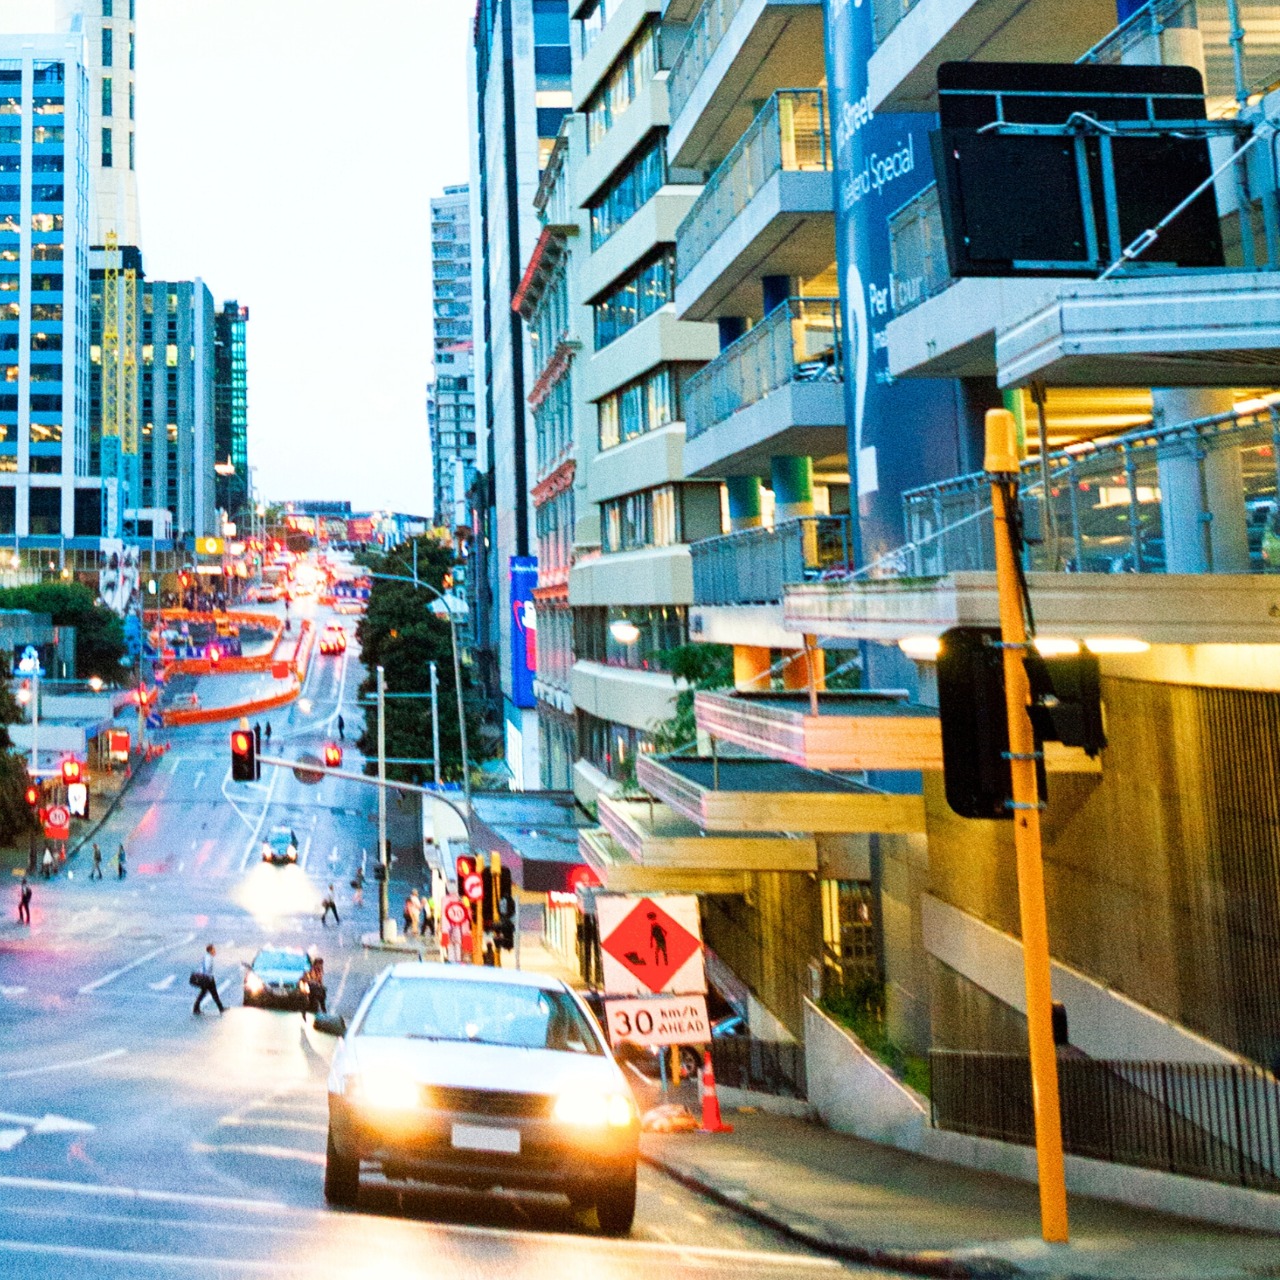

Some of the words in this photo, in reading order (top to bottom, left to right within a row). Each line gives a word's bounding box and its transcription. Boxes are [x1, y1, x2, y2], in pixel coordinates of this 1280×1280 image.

[841, 156, 871, 211] eekend
[870, 132, 914, 195] Special
[869, 282, 888, 318] Per
[614, 1009, 654, 1036] 30
[660, 1005, 699, 1019] km/h
[658, 1021, 704, 1035] AHEAD
